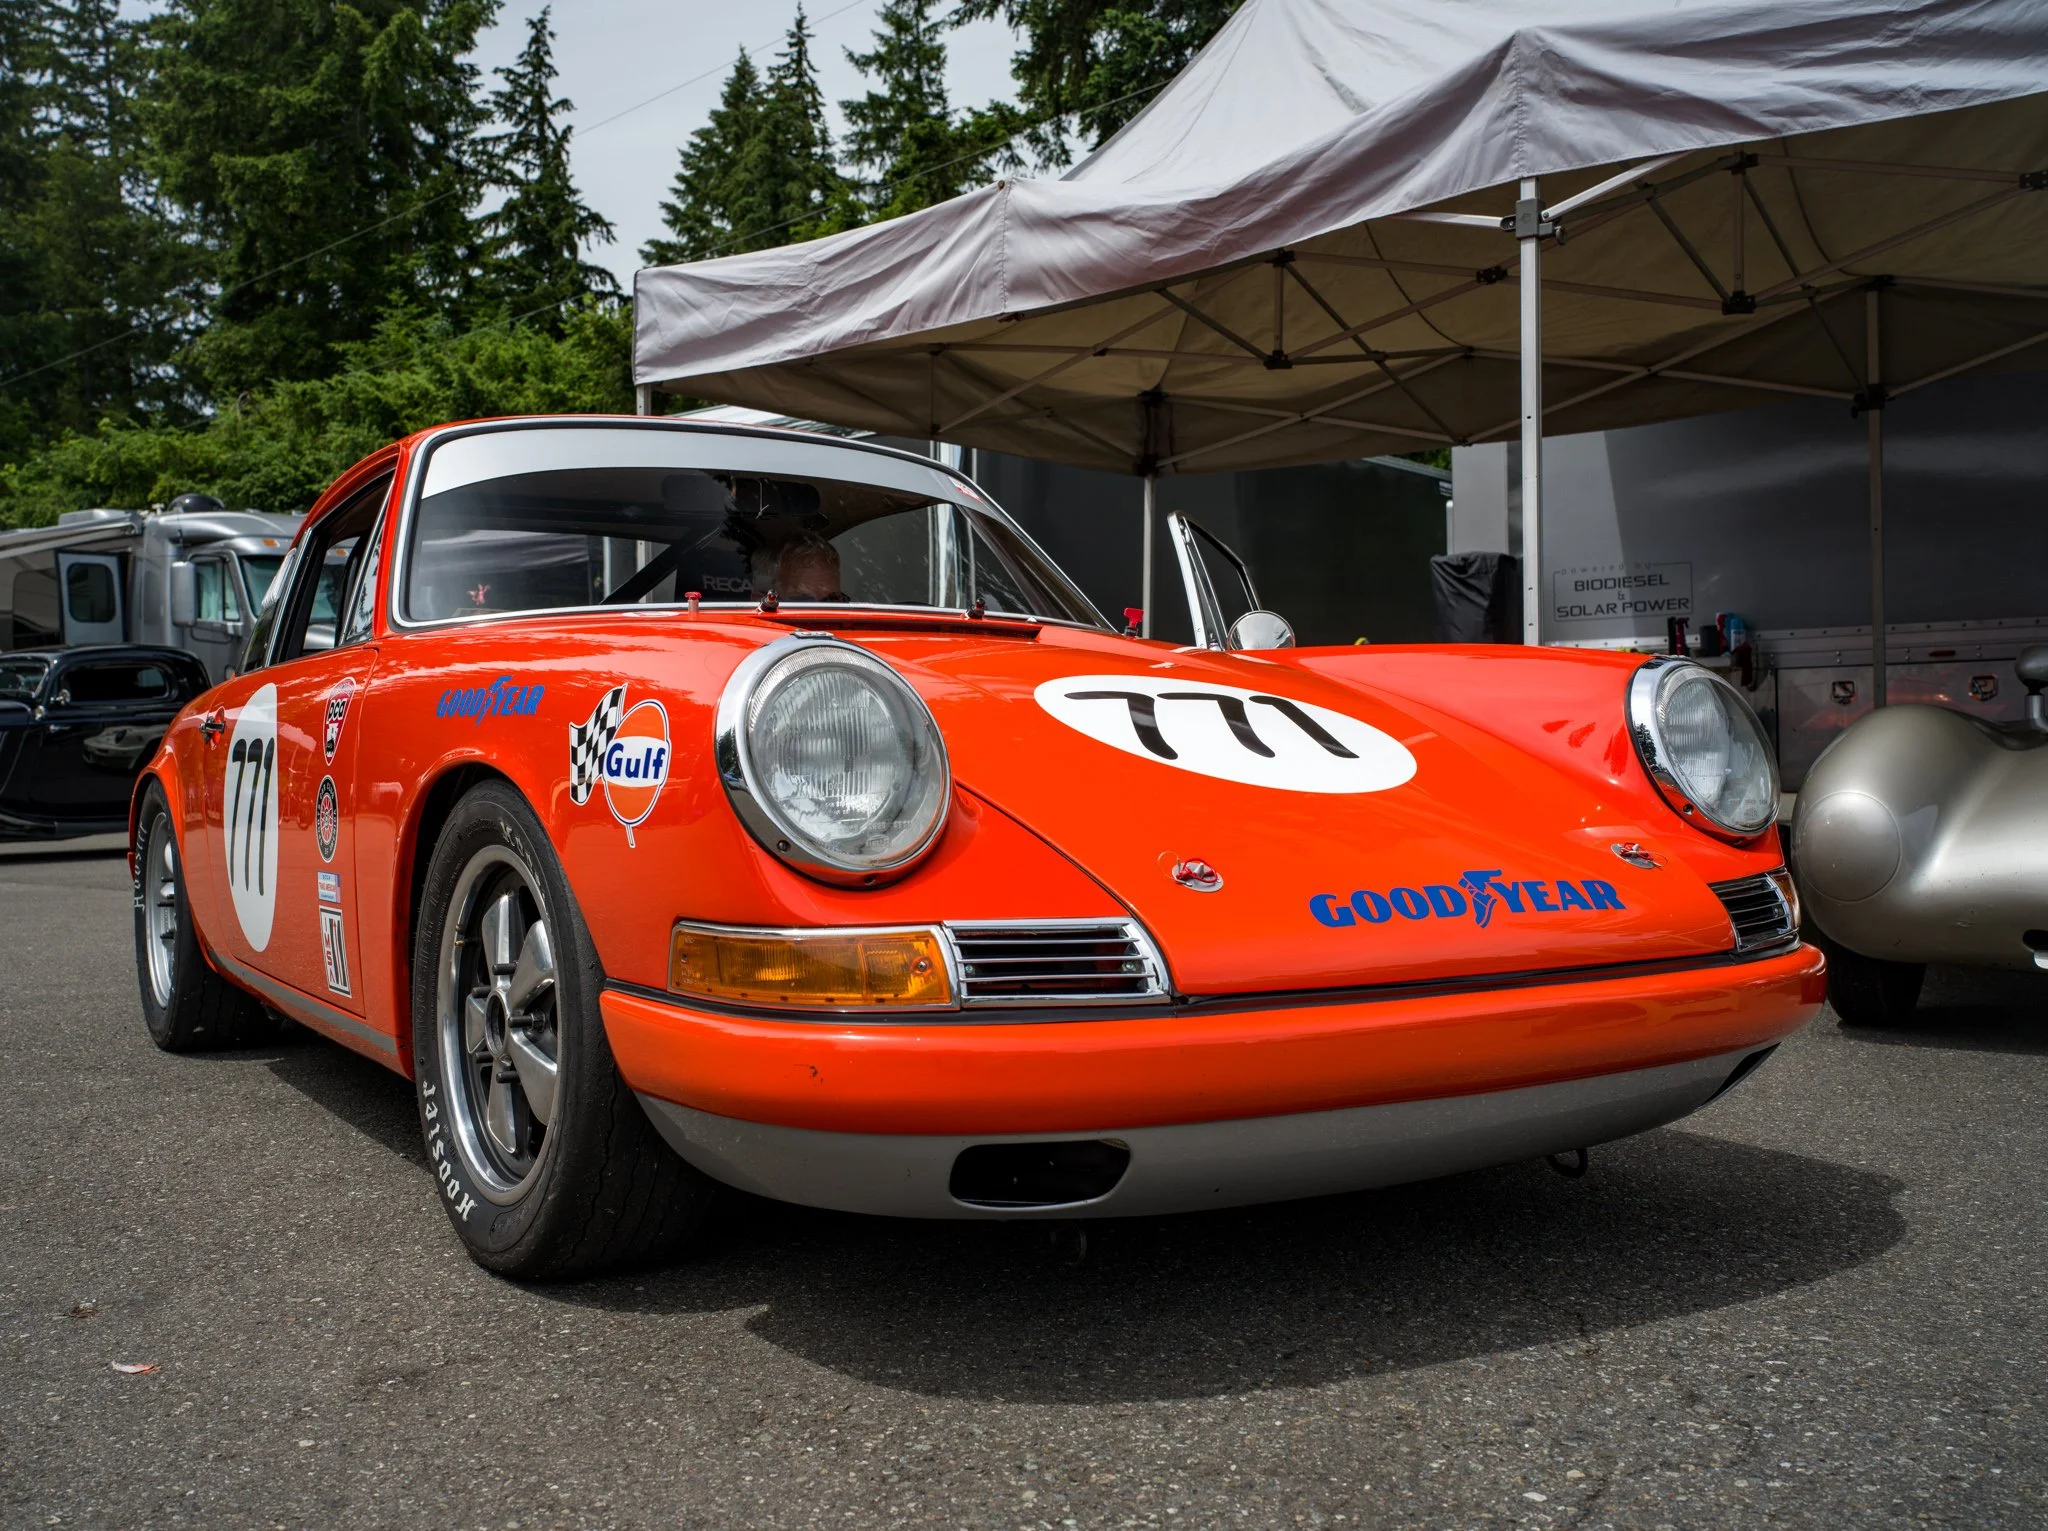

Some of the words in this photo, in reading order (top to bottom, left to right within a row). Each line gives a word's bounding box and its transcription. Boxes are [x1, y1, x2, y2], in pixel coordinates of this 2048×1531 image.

[702, 574, 754, 593] RECA
[1574, 573, 1670, 592] BIODIESEL
[1556, 602, 1618, 618] SOLAR
[1622, 597, 1690, 613] POWER
[327, 698, 347, 723] pca
[436, 676, 545, 726] GOODYEAR
[606, 743, 667, 780] Gulf
[1310, 869, 1625, 928] GOODYEAR
[422, 1080, 478, 1223] Hoosier
